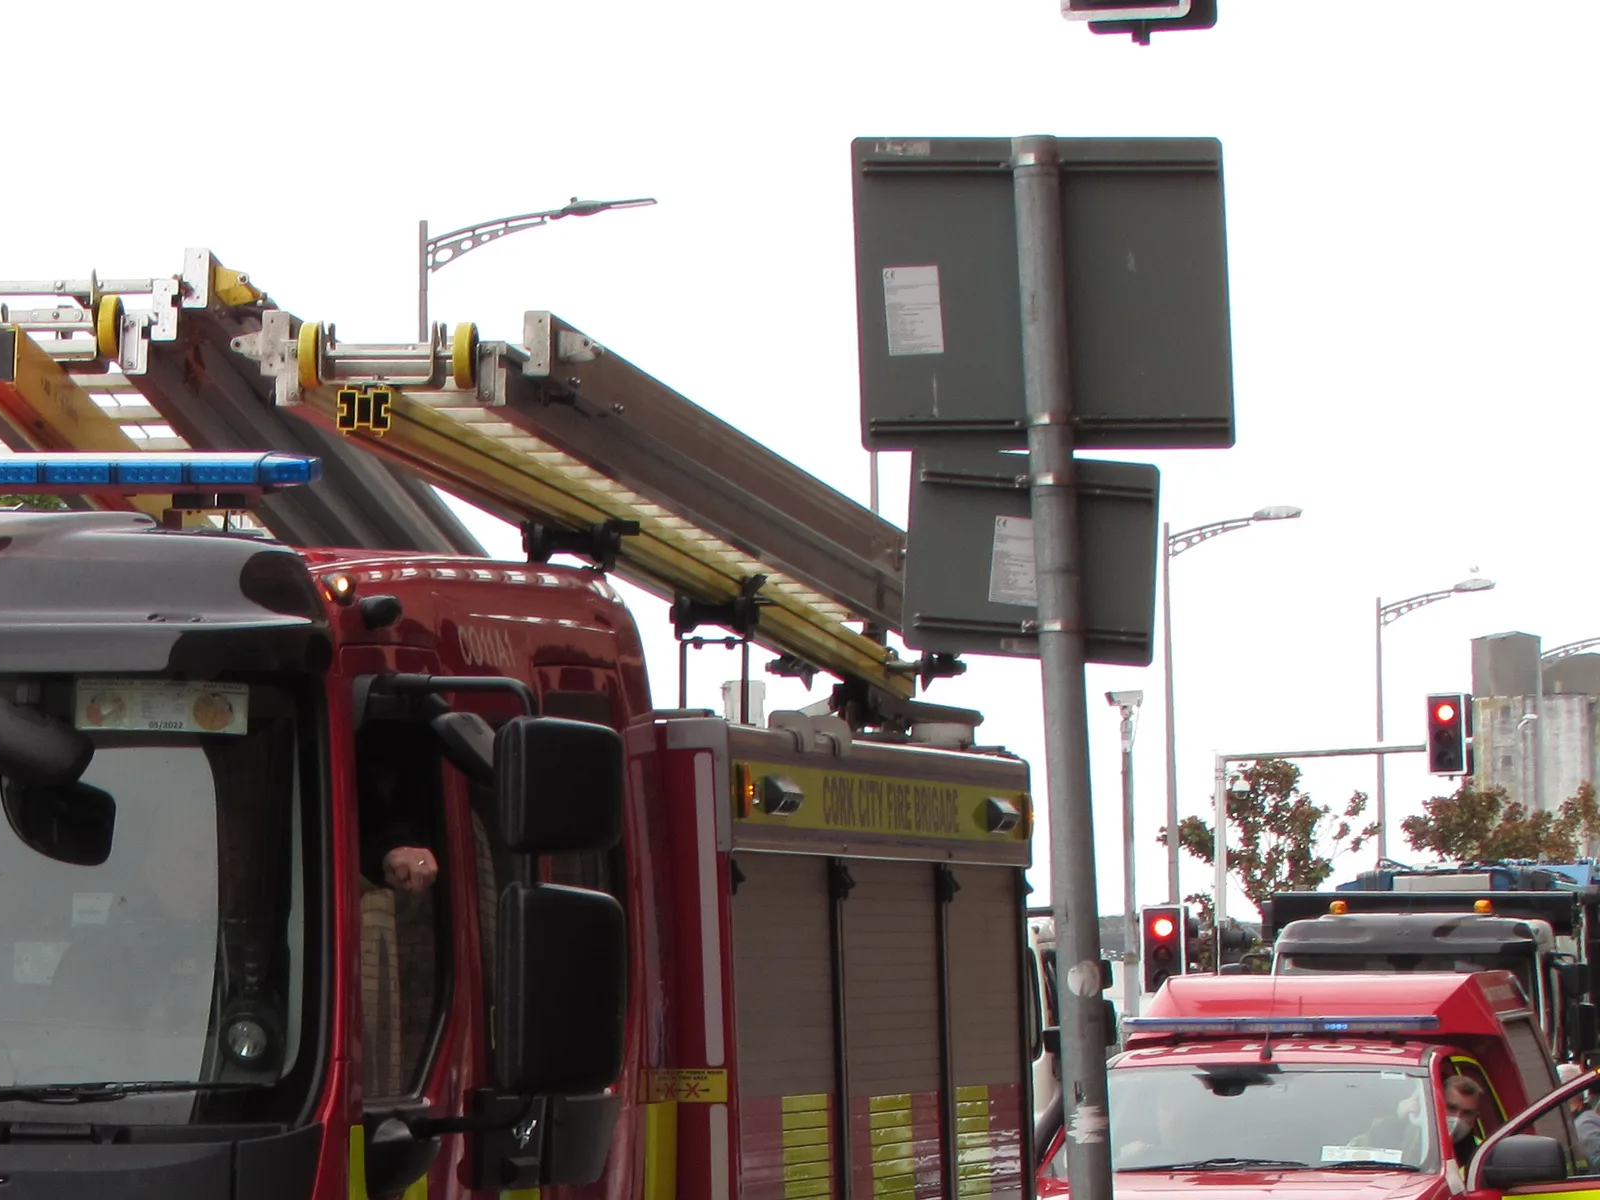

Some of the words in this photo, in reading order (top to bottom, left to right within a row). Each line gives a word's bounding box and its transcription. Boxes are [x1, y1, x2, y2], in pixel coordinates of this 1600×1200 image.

[148, 721, 184, 729] 05/2022
[822, 775, 856, 827] CORK
[858, 778, 884, 828] CITY
[886, 782, 912, 831] FIRE
[913, 785, 960, 834] BRIGADE
